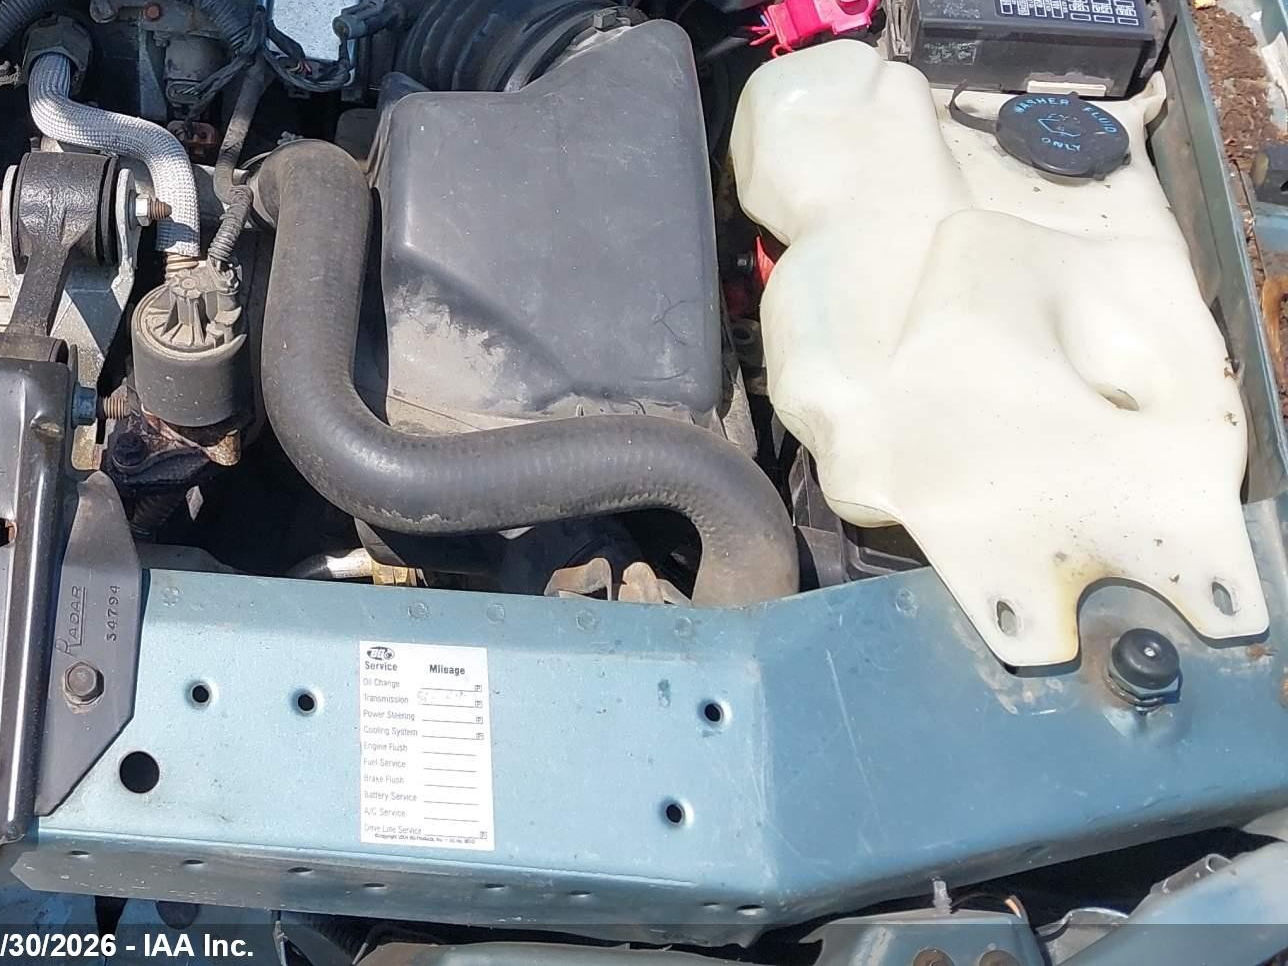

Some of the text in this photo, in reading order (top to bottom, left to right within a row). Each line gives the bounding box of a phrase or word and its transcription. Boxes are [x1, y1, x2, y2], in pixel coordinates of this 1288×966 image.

[1082, 107, 1118, 134] FLUID
[1041, 137, 1081, 152] ONLY
[106, 585, 120, 642] 34794
[365, 660, 466, 676] Service Mileage
[374, 678, 400, 688] Change
[364, 694, 409, 704] Transmission
[363, 709, 416, 722] Power Steering
[364, 726, 418, 738] Cooling System
[364, 742, 408, 752] Engine Flush
[364, 758, 406, 768] Fuel Service
[364, 774, 404, 784] Brake Flush
[364, 790, 418, 802] Battery Service
[379, 808, 406, 817] Service
[382, 825, 396, 833] Line
[398, 826, 422, 835] Service
